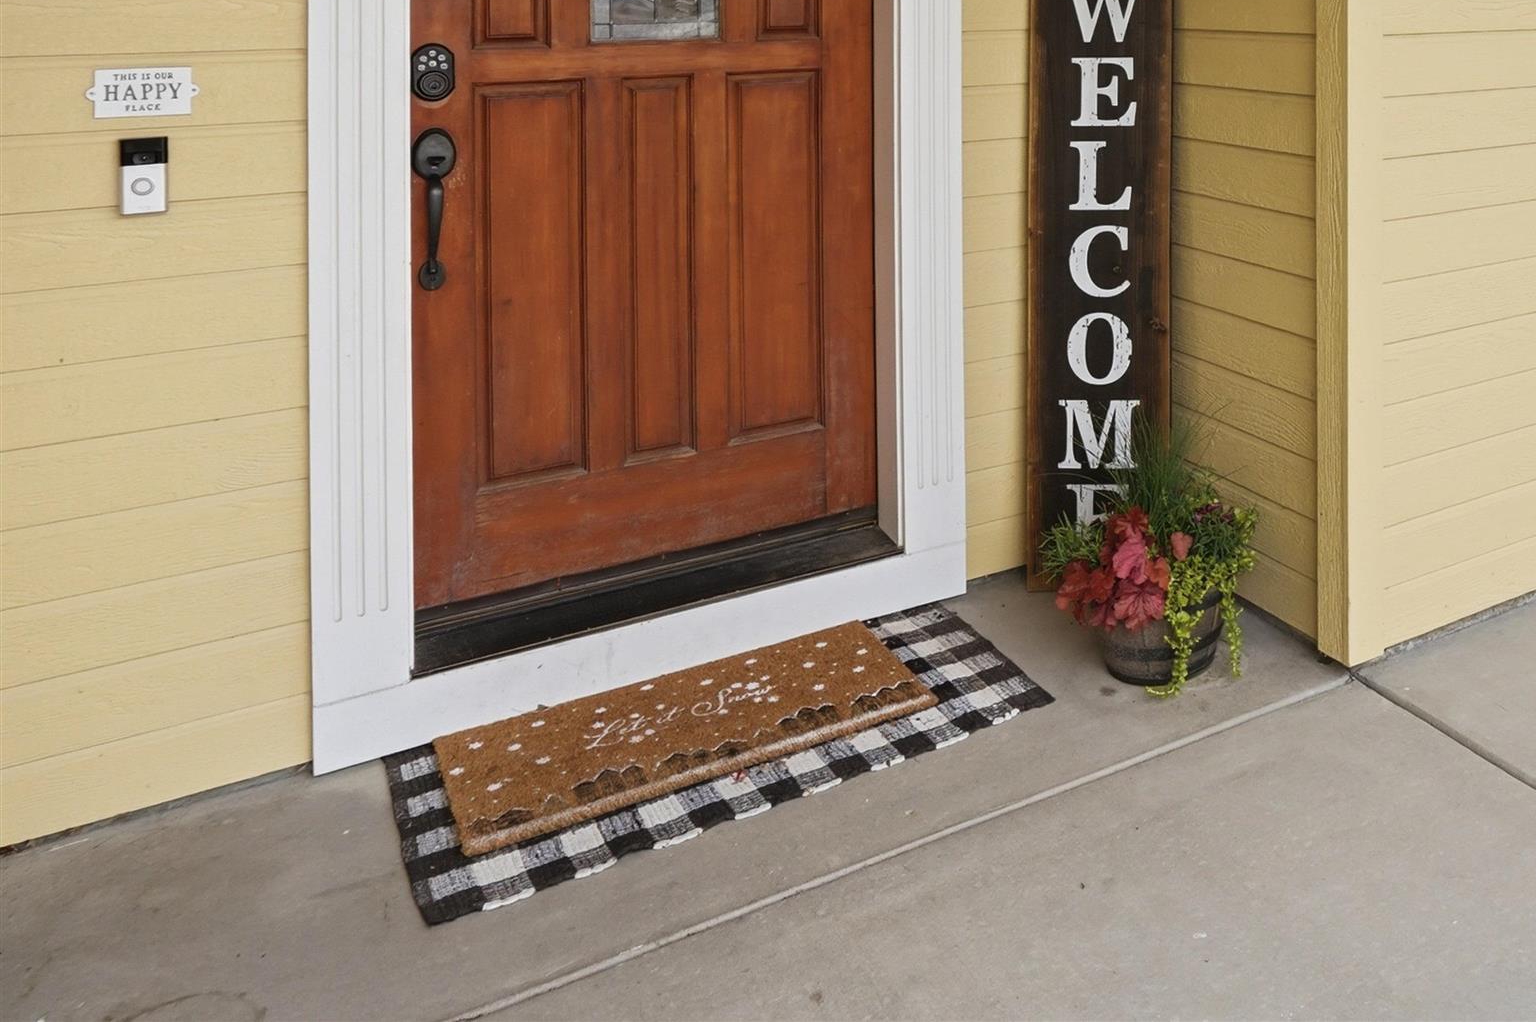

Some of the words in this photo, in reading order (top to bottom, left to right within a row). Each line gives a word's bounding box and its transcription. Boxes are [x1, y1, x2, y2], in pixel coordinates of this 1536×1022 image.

[113, 73, 137, 81] THIS
[154, 72, 174, 80] OUR
[103, 82, 182, 101] HAPPY
[125, 103, 161, 112] PLACE
[584, 715, 651, 750] Let
[656, 706, 685, 724] it
[691, 684, 776, 716] Snow
